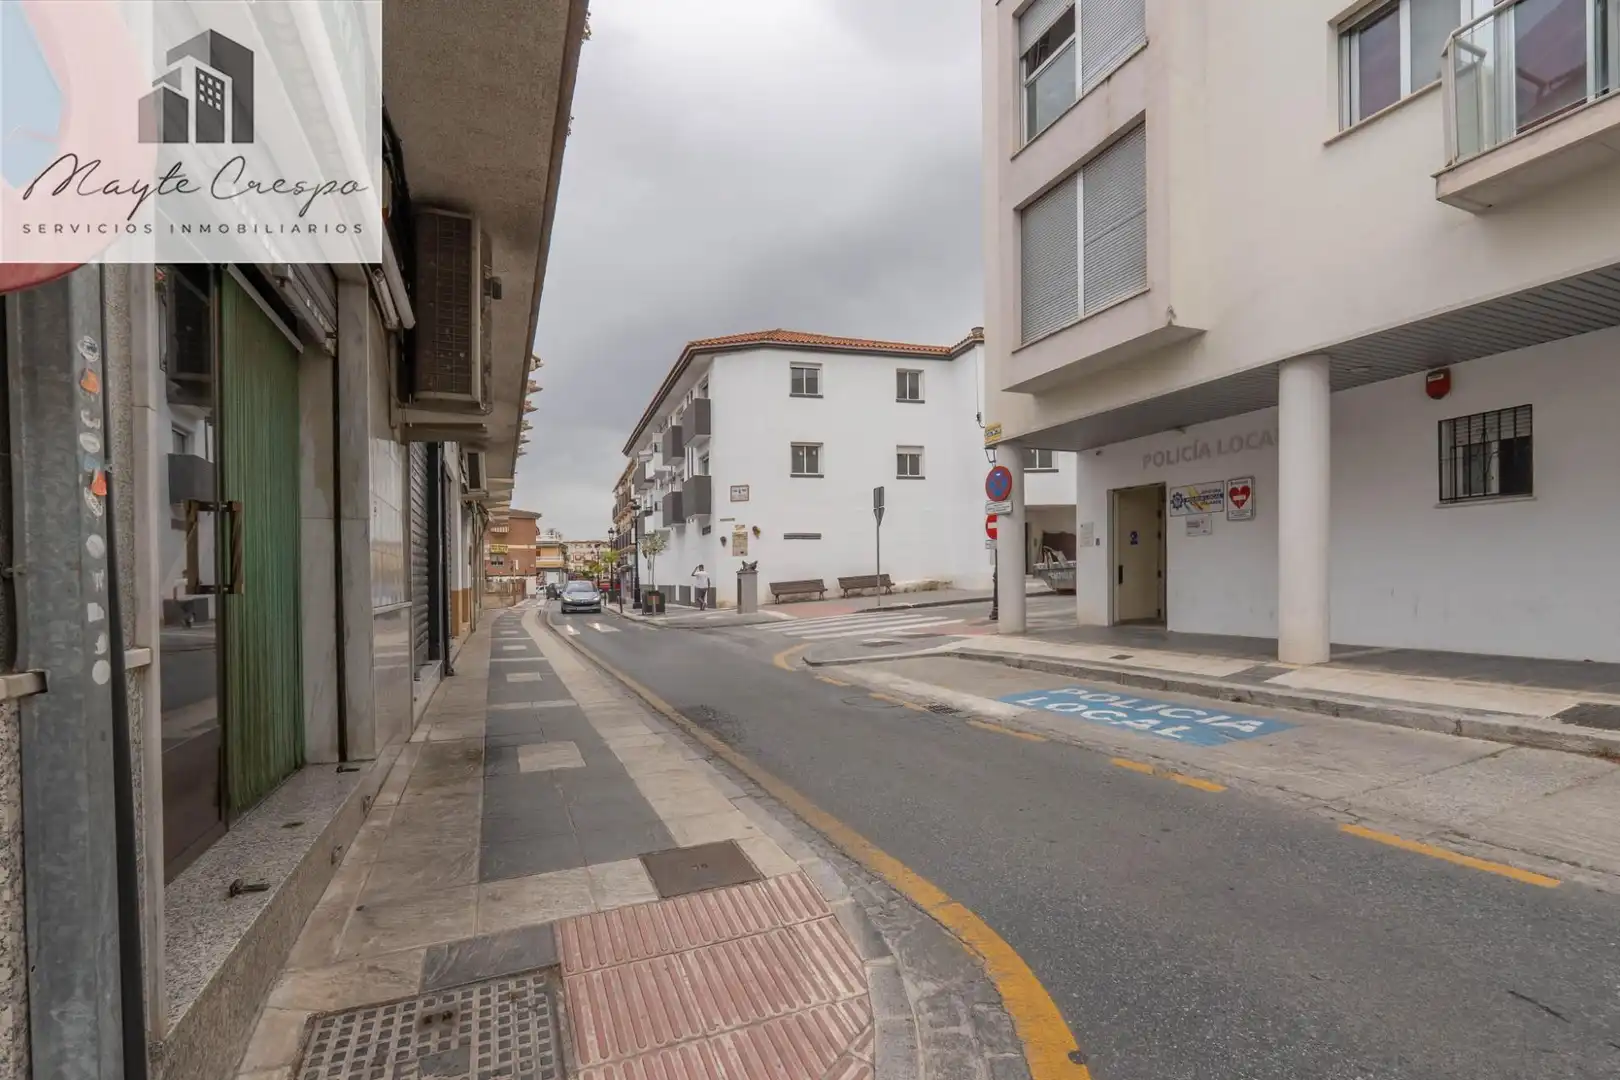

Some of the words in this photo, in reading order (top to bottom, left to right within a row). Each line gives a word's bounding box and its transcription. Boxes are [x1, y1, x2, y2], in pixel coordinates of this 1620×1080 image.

[1142, 439, 1212, 470] POLICÍA
[1217, 428, 1279, 455] LOCA
[1017, 696, 1192, 739] LOCAL
